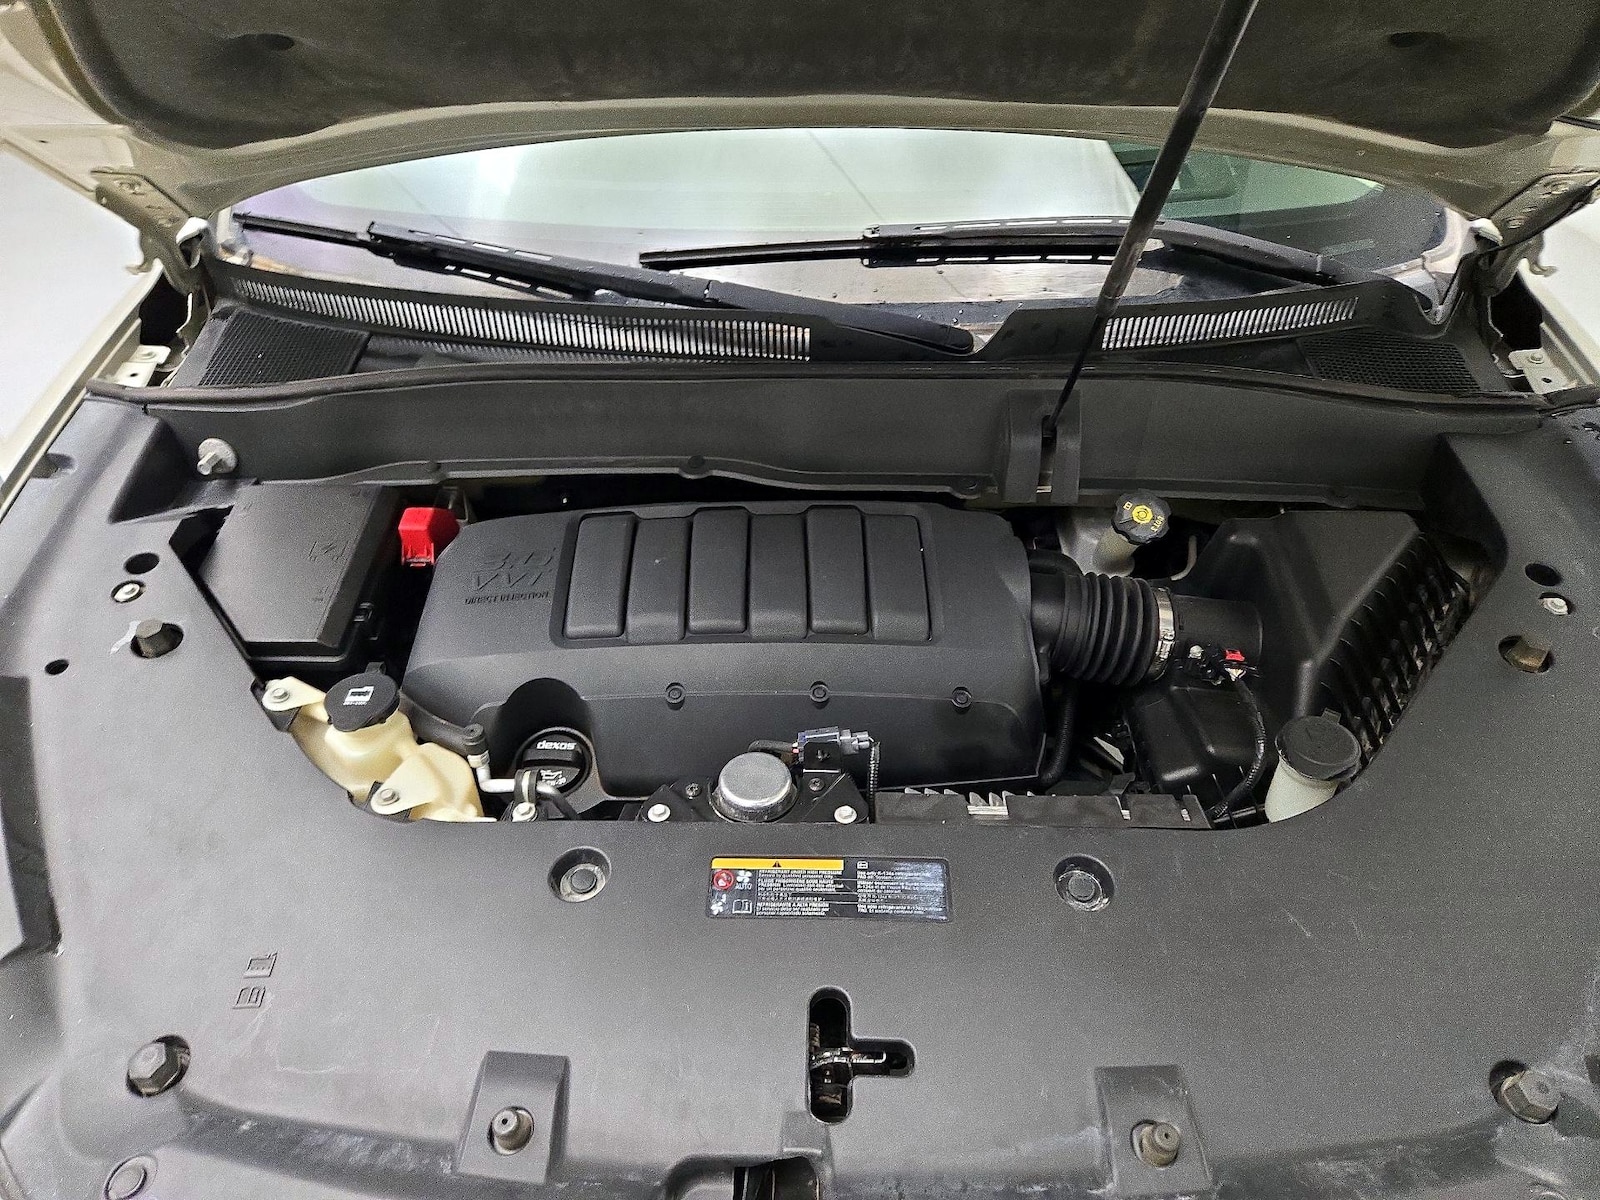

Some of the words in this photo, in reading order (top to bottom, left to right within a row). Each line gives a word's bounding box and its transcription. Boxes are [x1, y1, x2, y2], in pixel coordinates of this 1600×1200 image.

[464, 595, 498, 605] DIRECT
[500, 591, 549, 602] INJECTION
[536, 740, 577, 750] dexos
